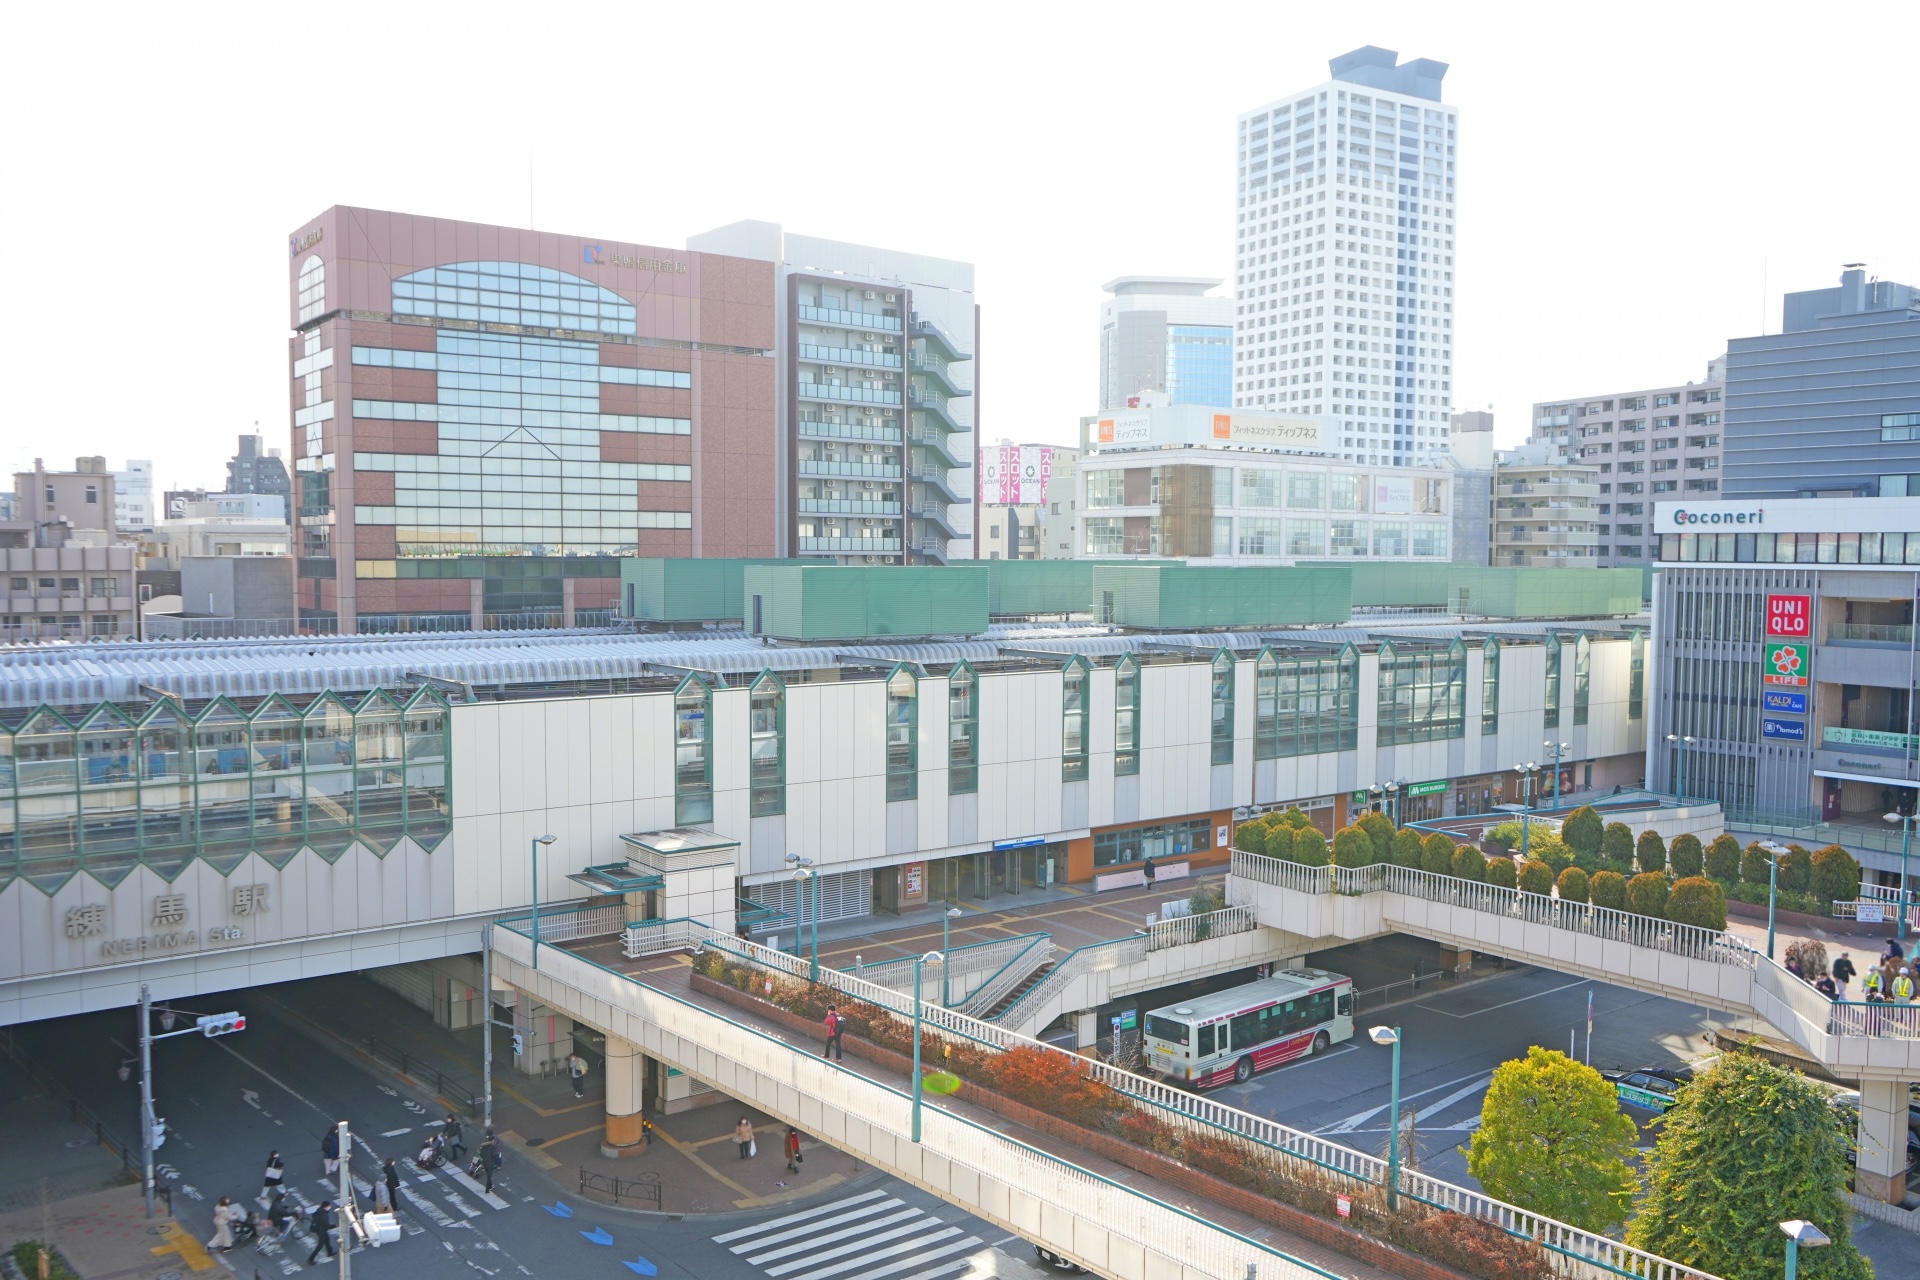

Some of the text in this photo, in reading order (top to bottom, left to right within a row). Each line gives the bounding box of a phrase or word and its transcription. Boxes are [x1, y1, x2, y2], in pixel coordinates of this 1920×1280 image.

[610, 253, 686, 273] 巣鴨信用金庫
[1116, 428, 1148, 440] ティップネス
[1277, 425, 1318, 440] ティップネス
[1010, 451, 1020, 499] スロット
[1674, 509, 1763, 526] Coconeri
[1772, 600, 1802, 615] UNI
[1771, 616, 1804, 633] QLO
[1772, 675, 1799, 685] LIFE
[1767, 695, 1792, 704] KALDI
[64, 883, 270, 939] 練馬駅
[102, 925, 246, 957] NERIMA Sta.
